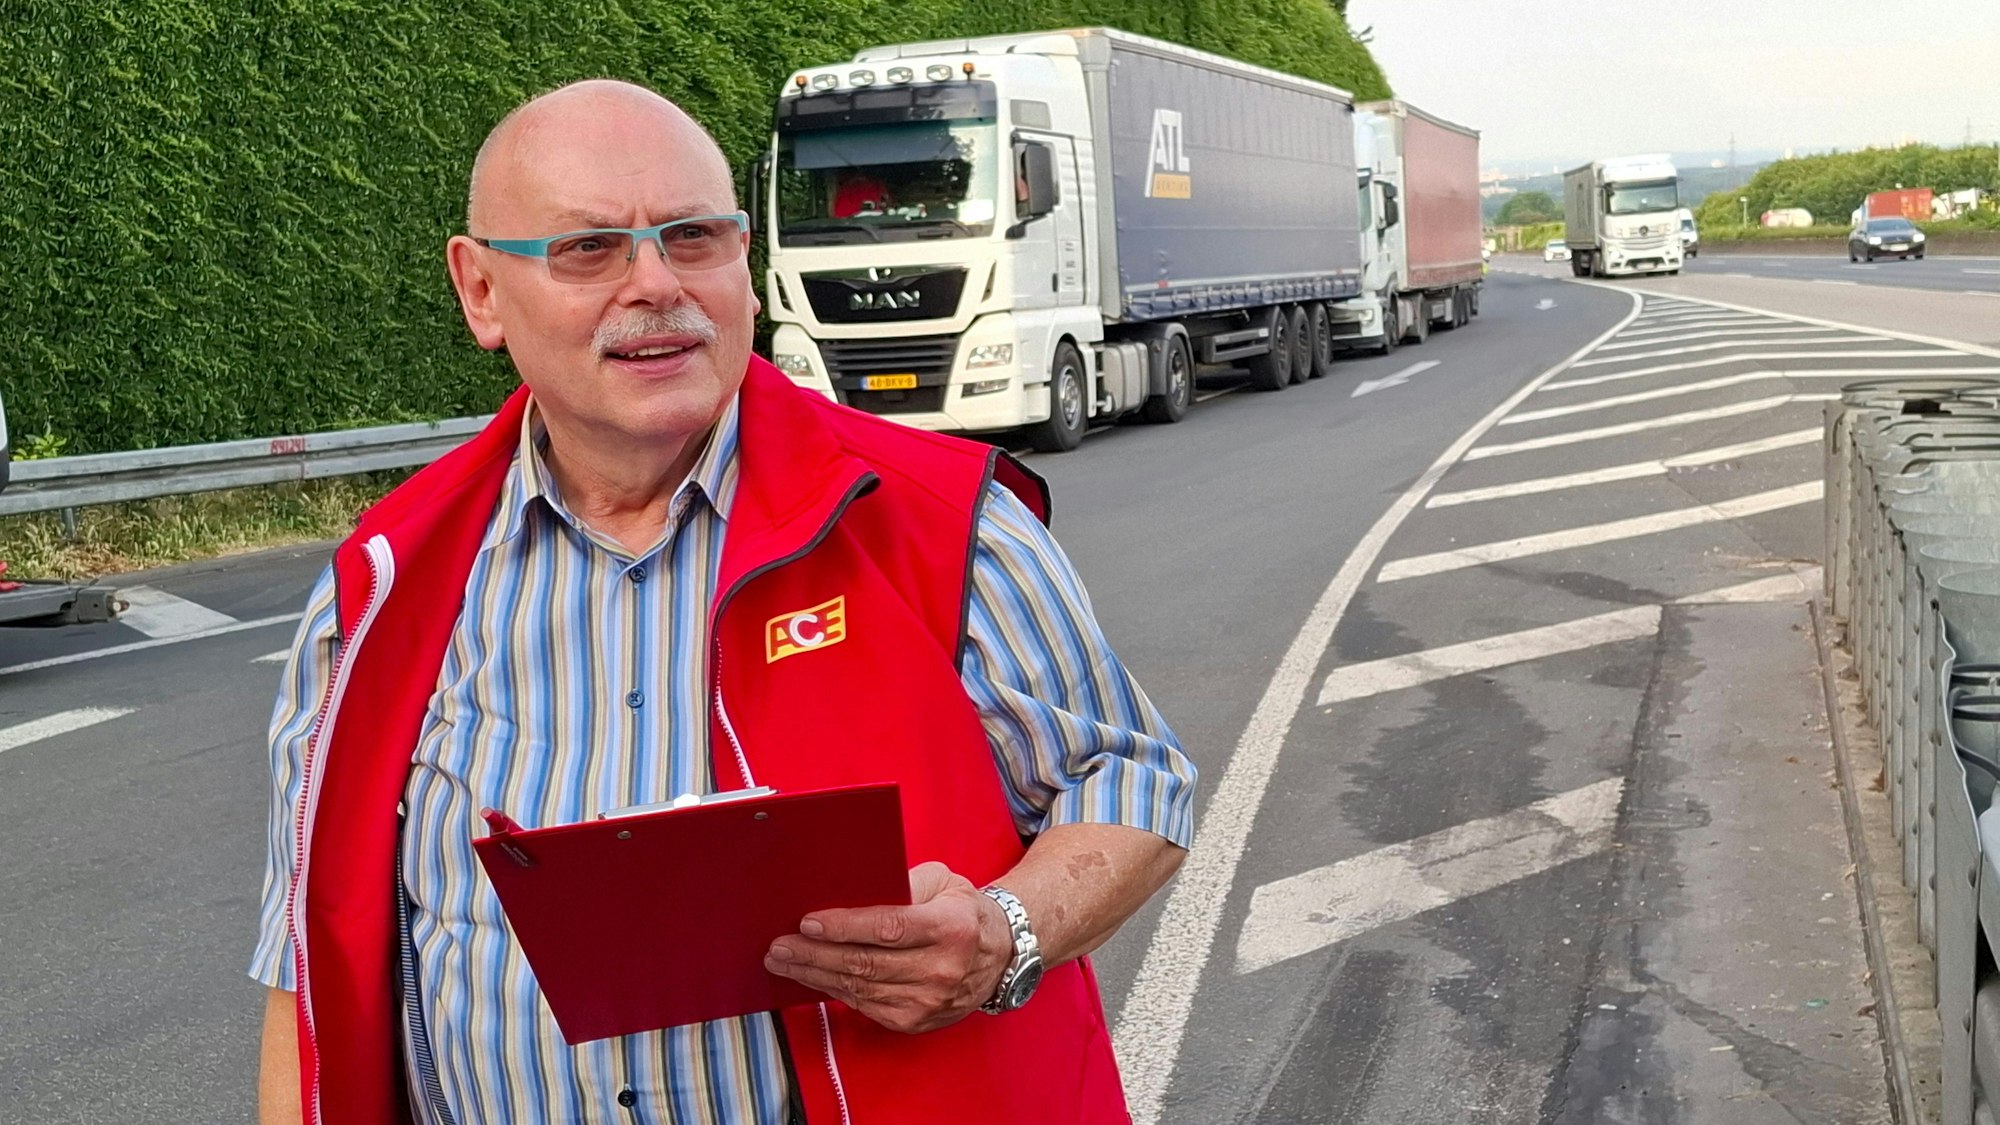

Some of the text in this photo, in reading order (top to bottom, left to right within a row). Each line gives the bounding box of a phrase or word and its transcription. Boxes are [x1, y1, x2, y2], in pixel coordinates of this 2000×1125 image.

[1144, 109, 1190, 197] ATL
[850, 290, 920, 310] MAN
[768, 597, 844, 661] ACE
